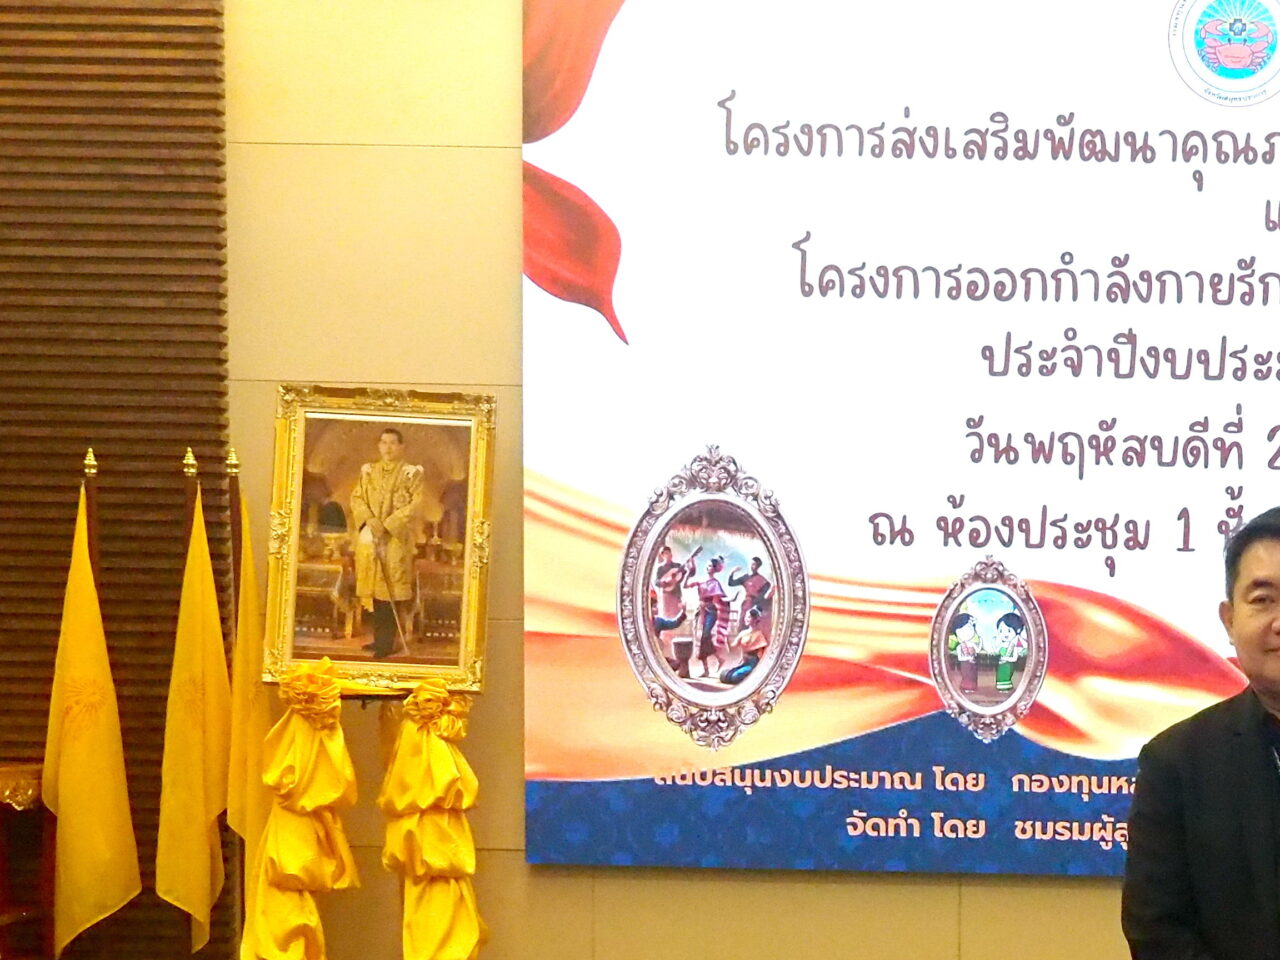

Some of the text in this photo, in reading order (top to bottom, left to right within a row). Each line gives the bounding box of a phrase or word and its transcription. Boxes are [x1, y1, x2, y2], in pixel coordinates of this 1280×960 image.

[965, 403, 1244, 480] วันพฤหัสบดีที่
[868, 511, 915, 547] ณ
[935, 494, 1151, 576] ห้องประชุม
[1176, 506, 1196, 552] 1
[933, 766, 986, 792] โดย
[845, 809, 921, 838] จัดทำ
[931, 812, 986, 839] โดย
